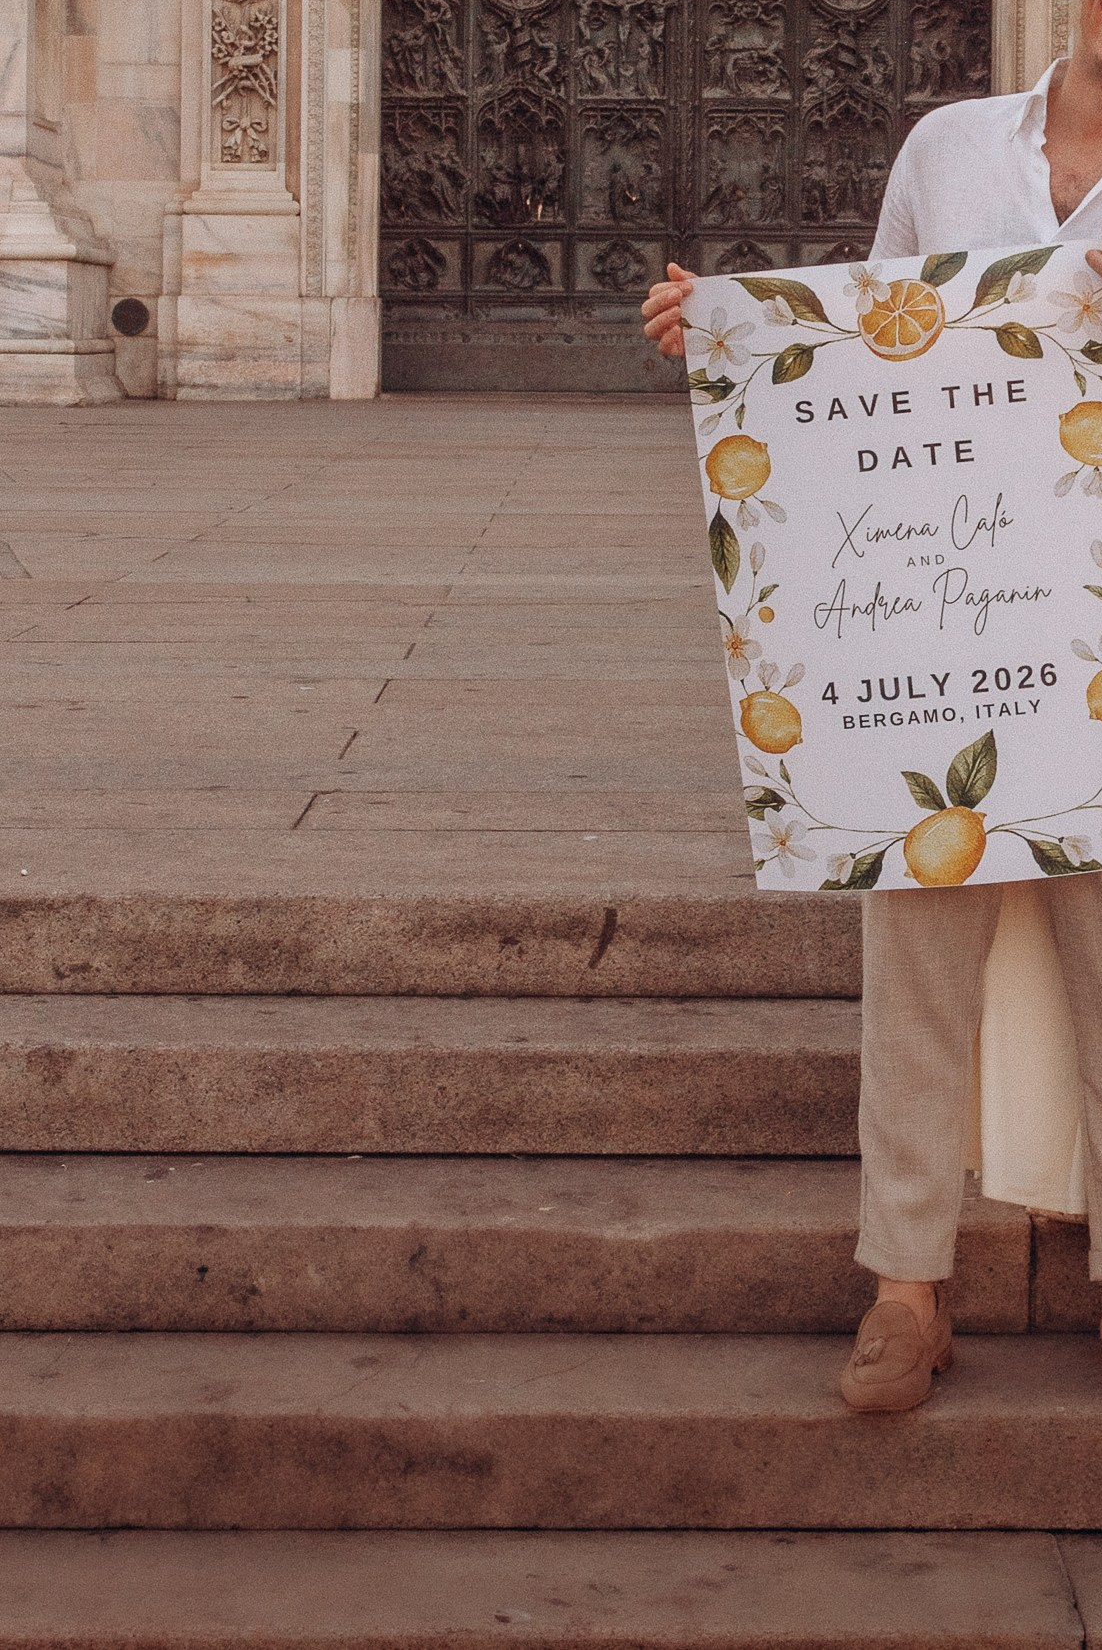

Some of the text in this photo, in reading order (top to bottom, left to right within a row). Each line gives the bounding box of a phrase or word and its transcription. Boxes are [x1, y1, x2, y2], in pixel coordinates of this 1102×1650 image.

[794, 379, 1027, 424] SAVE THE
[857, 439, 975, 473] DATE
[831, 492, 1014, 569] Ximena Caló
[906, 553, 946, 568] AND
[813, 567, 1053, 639] Andrea Paganin
[821, 662, 1058, 705] 4 JULY 2026
[842, 698, 1041, 730] BERGAMO, ITALY
